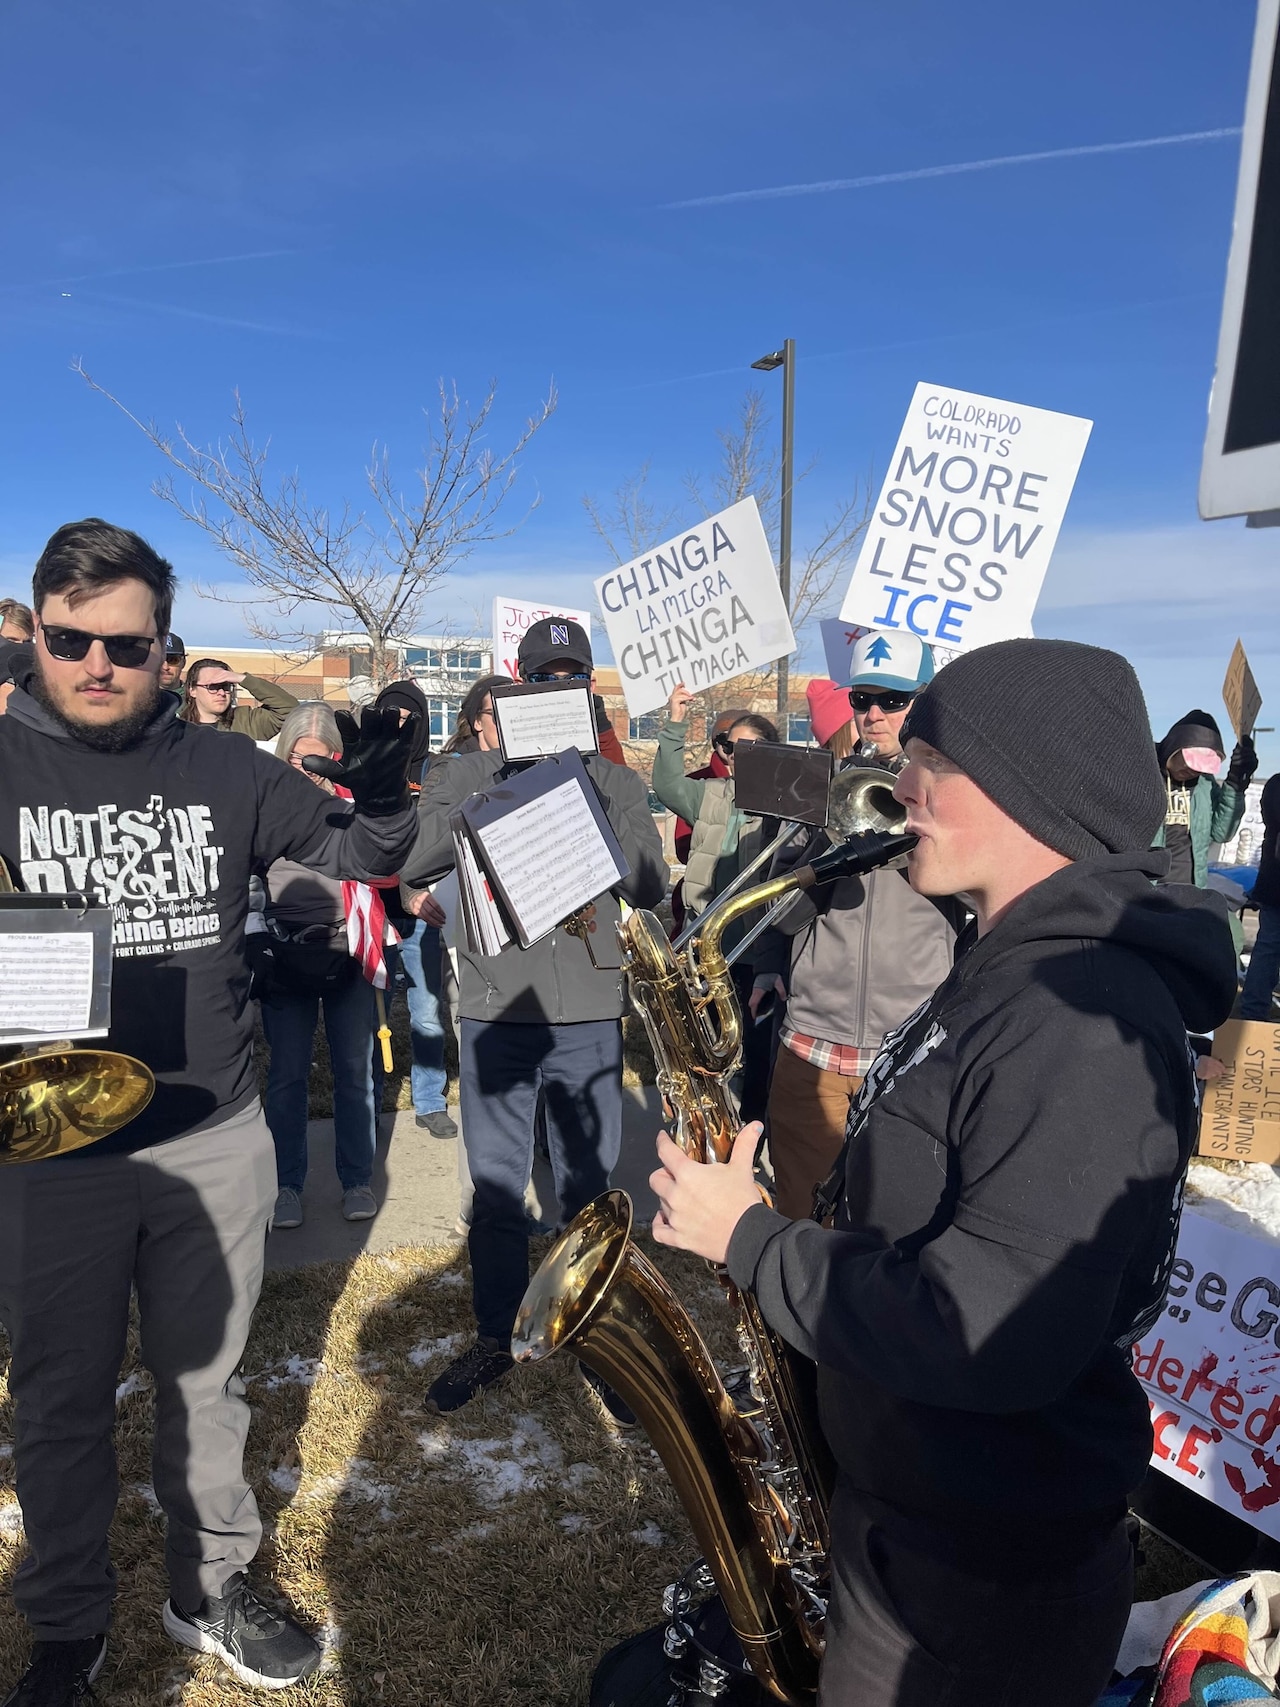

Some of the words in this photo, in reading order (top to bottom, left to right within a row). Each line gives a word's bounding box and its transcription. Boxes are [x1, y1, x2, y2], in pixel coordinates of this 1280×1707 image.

[923, 396, 1022, 435] COLORADO
[926, 422, 1012, 458] WANTS
[894, 445, 1048, 513] MORE
[879, 488, 1044, 560] SNOW
[601, 521, 736, 613] CHINGA
[869, 537, 1008, 602] LESS
[636, 605, 660, 634] LA
[662, 570, 732, 623] MIGRA
[872, 585, 973, 643] ICE
[549, 624, 570, 646] N
[620, 595, 755, 680] CHINGA
[690, 642, 750, 686] MAGA
[19, 804, 162, 861] NOTES
[166, 804, 215, 850] OF
[115, 946, 134, 958] FORT
[135, 943, 165, 956] COLLINS
[172, 939, 201, 951] COLORADO
[168, 913, 220, 938] BAND
[1241, 1046, 1266, 1094] STOPS
[1211, 1060, 1237, 1152] IMMIGRANTS
[1235, 1101, 1259, 1155] HUNTING
[1230, 1276, 1280, 1350] G
